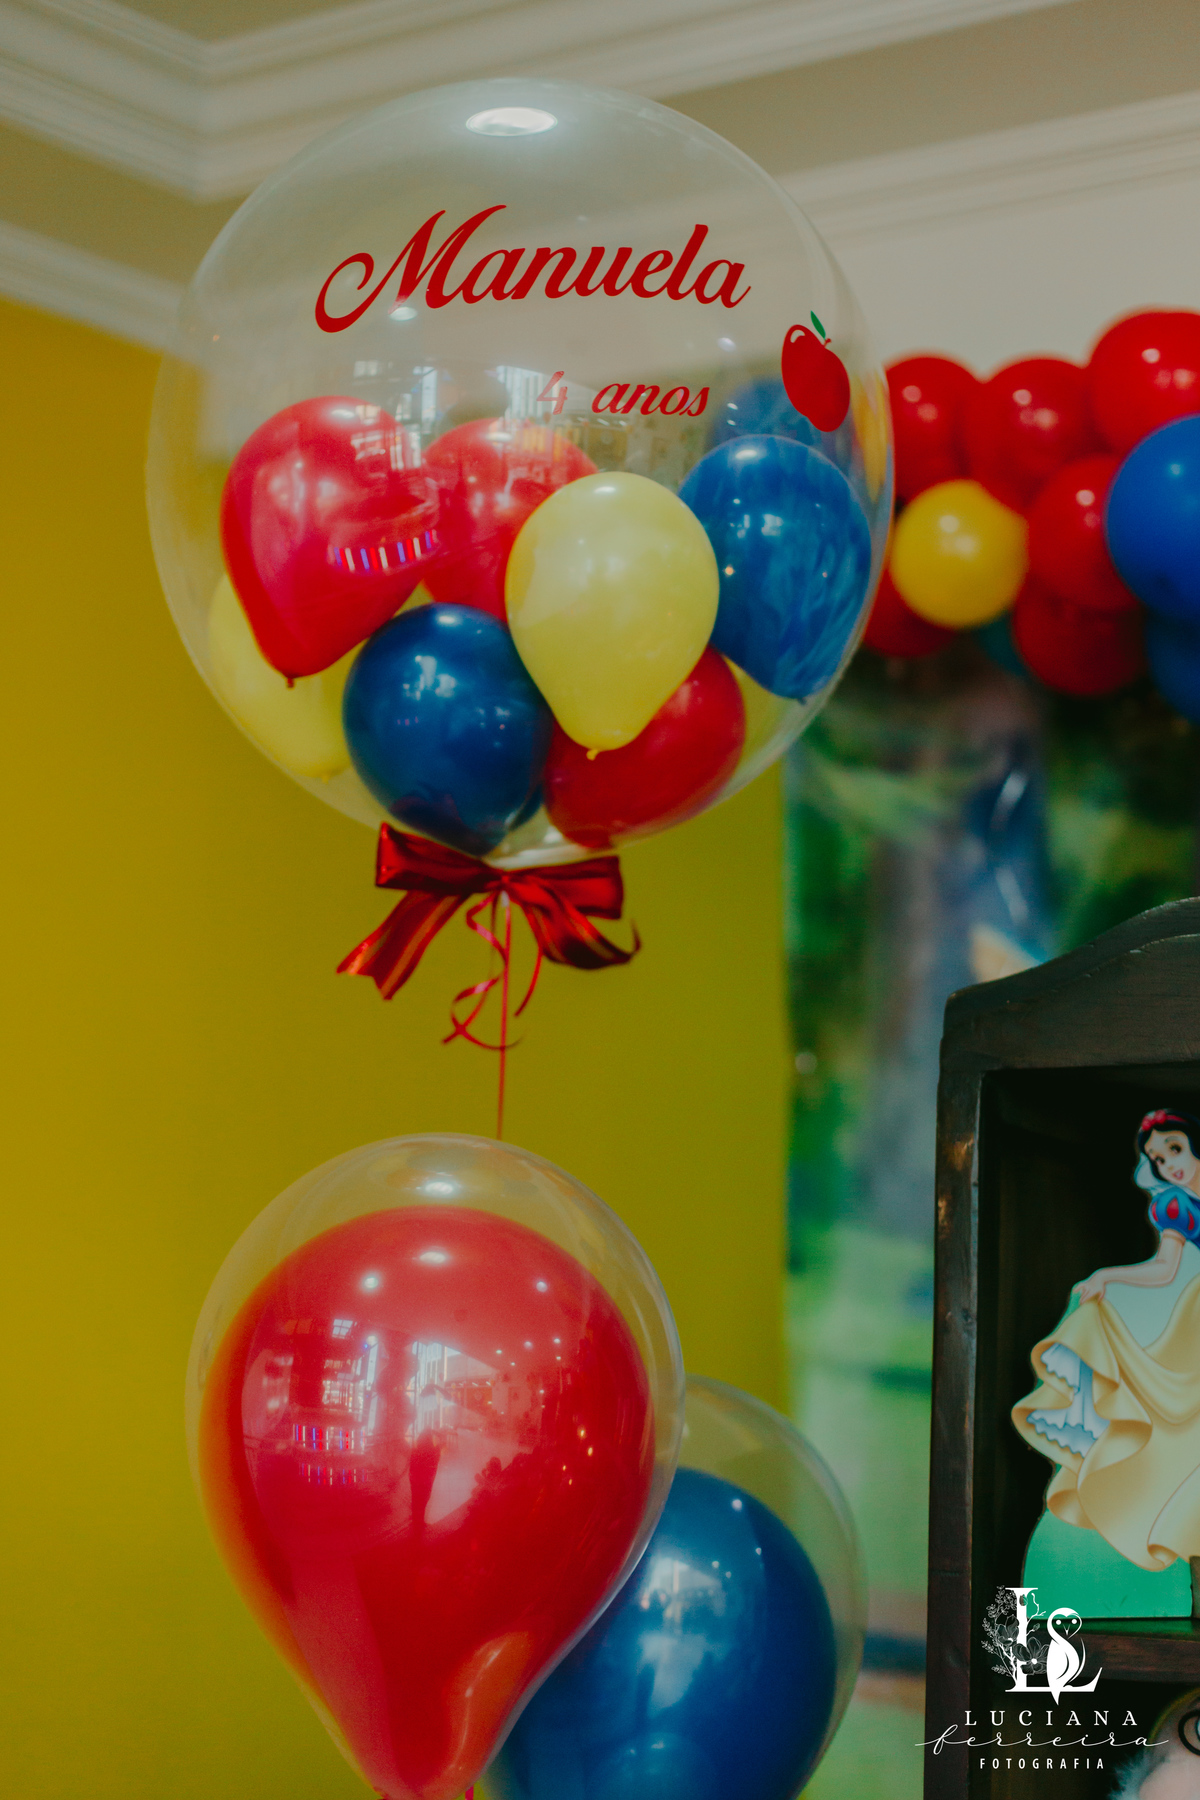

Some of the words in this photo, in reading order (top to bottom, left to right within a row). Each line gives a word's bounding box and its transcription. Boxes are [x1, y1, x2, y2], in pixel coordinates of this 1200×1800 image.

[315, 204, 751, 333] Manuela
[536, 370, 568, 415] 4
[591, 383, 710, 417] anos
